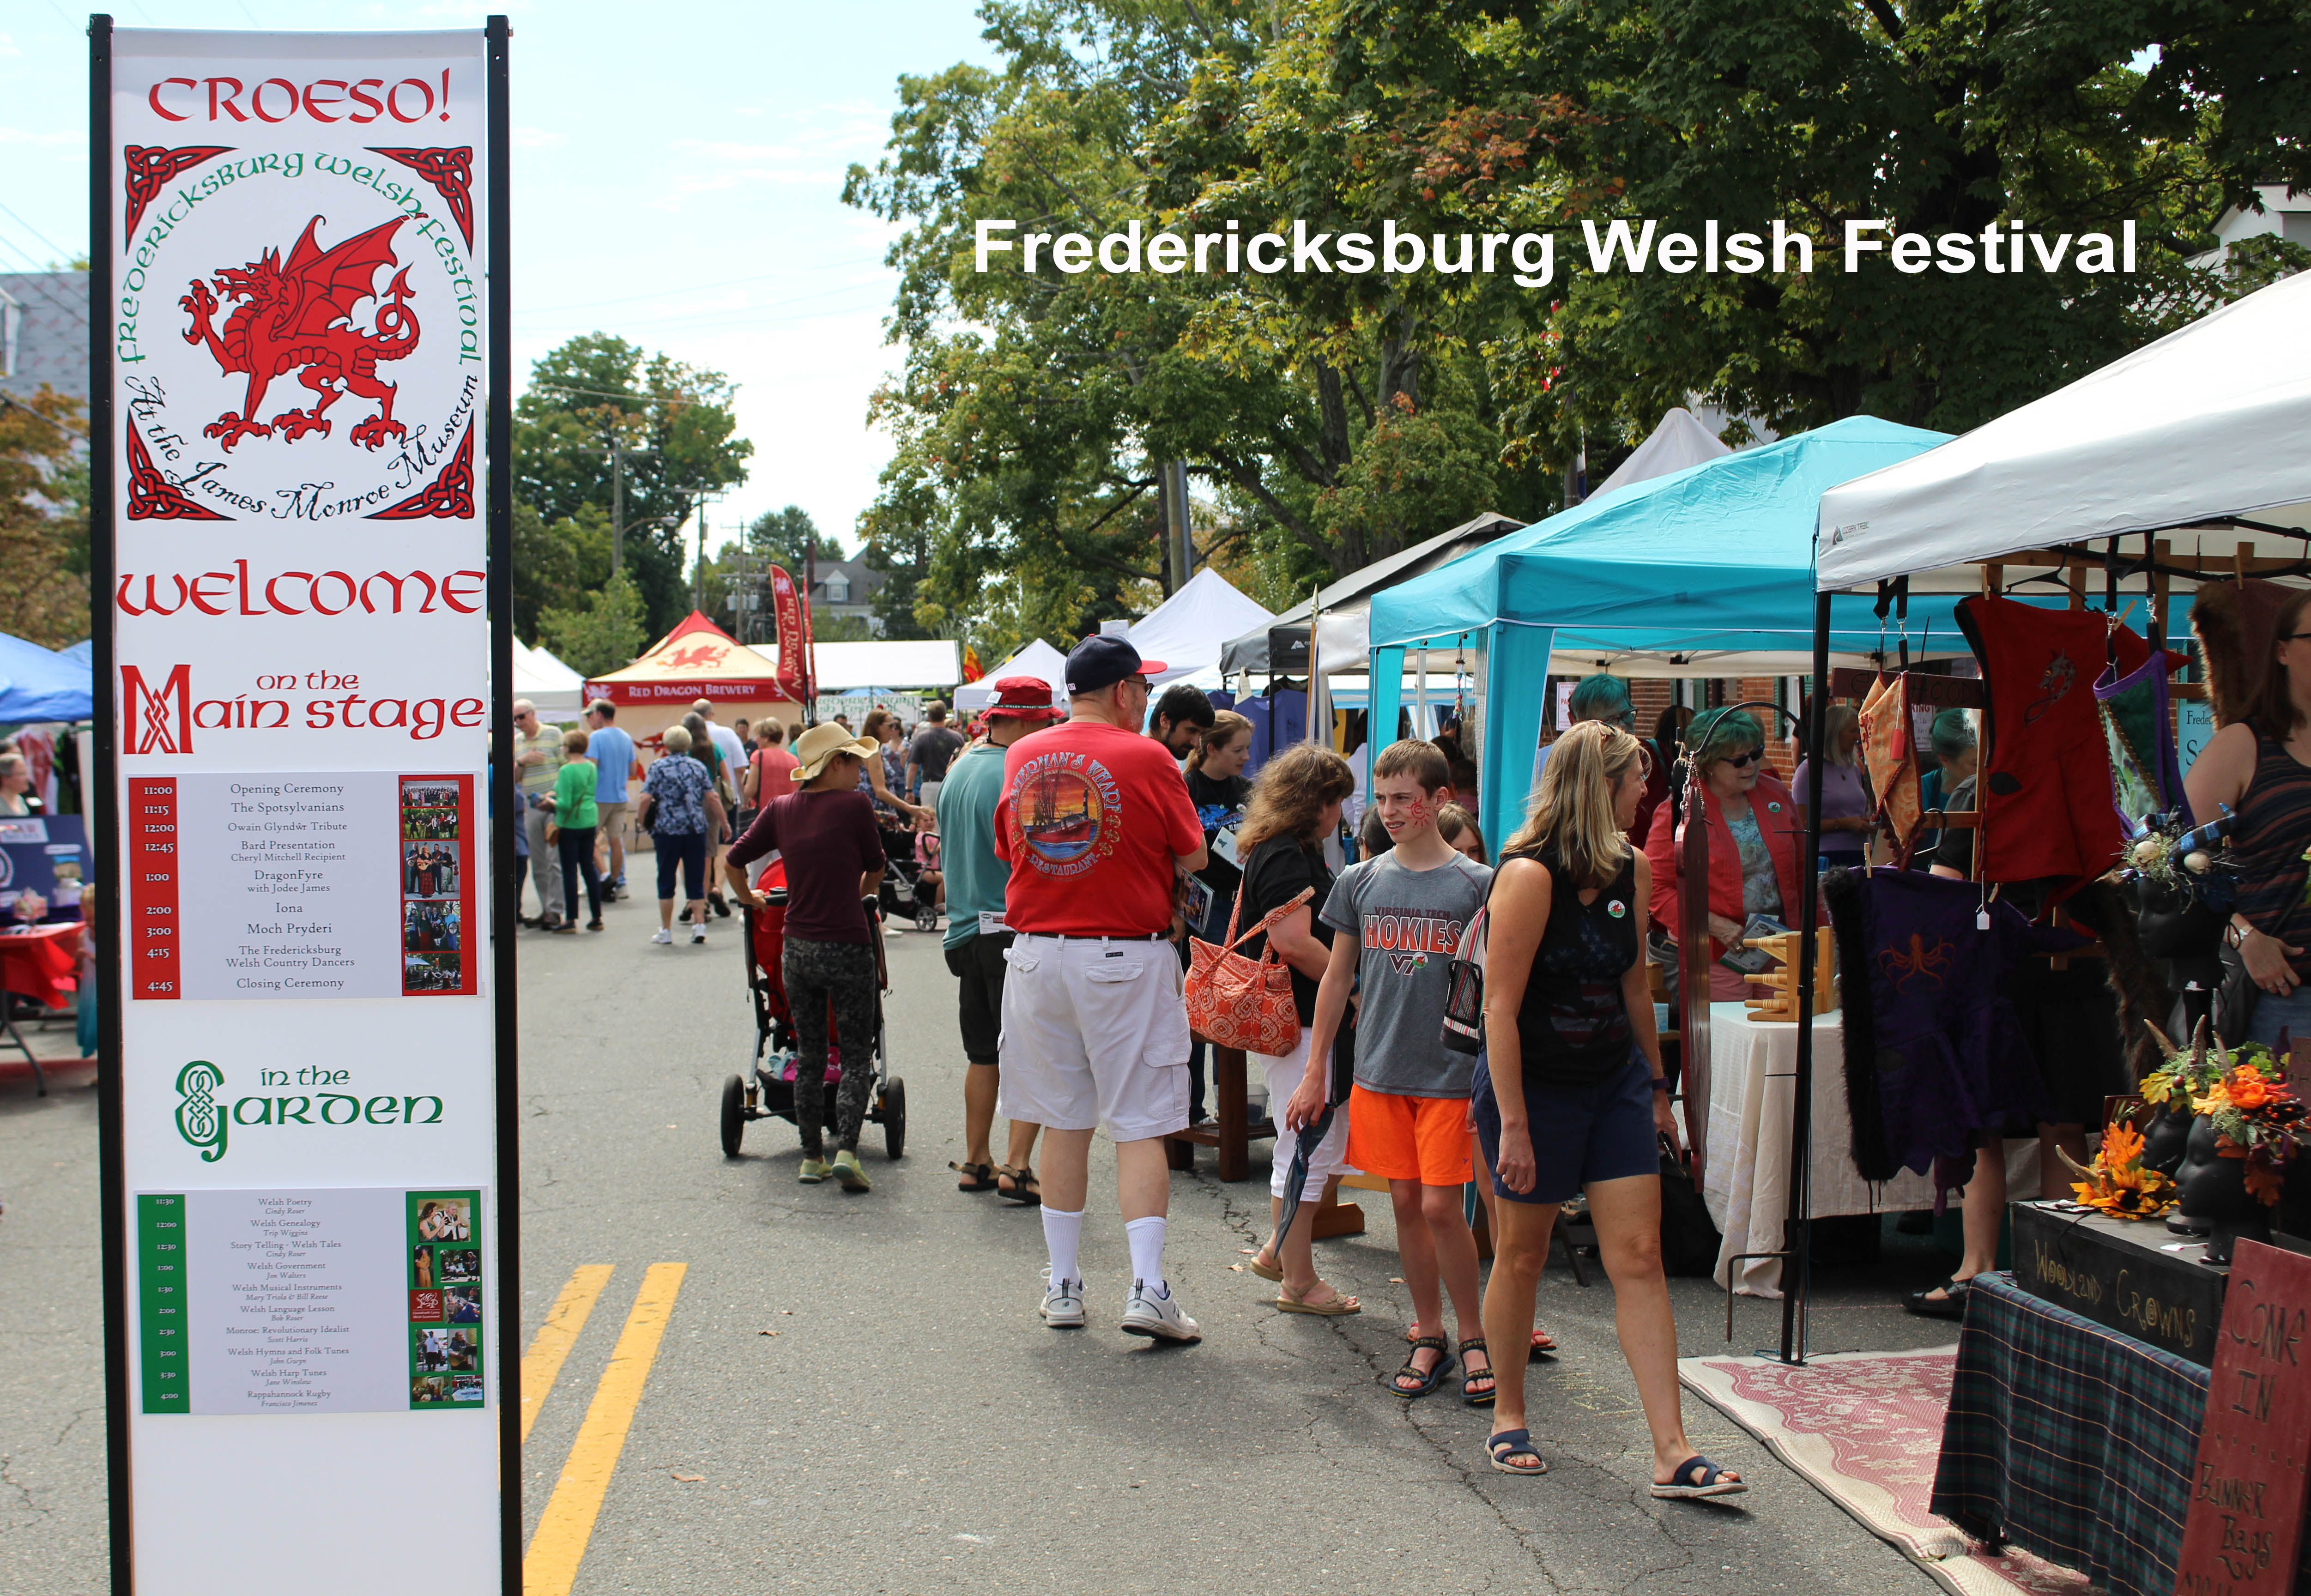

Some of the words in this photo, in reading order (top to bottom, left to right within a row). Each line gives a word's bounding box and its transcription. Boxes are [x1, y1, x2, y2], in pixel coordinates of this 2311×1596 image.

[149, 67, 450, 123] CROESO!
[125, 374, 168, 422] At
[386, 374, 478, 490] Museum
[147, 420, 190, 461] the
[164, 459, 267, 513] James
[270, 481, 390, 521] Monroe
[257, 676, 296, 689] on
[304, 670, 358, 689] the
[629, 686, 651, 697] RED
[654, 685, 702, 696] DRAGON
[705, 683, 756, 695] BREWERY
[144, 786, 173, 795] 11:00
[230, 784, 280, 796] Opening
[284, 783, 344, 796] Ceremony
[1086, 759, 1122, 813] WHARF
[144, 805, 169, 816] 11:15
[230, 802, 254, 812] The
[258, 801, 344, 816] Spotsylvanians
[145, 824, 175, 833] 12:00
[228, 822, 261, 831] Owain
[310, 821, 347, 830] Tribute
[145, 842, 174, 853] 12:45
[241, 840, 266, 850] Bard
[269, 840, 335, 850] Presentation
[230, 853, 261, 864] Cheryl
[264, 852, 302, 861] Mitchell
[304, 852, 345, 863] Recipient
[145, 873, 169, 882] 1:00
[254, 870, 323, 883] DragonFyre
[247, 883, 270, 892] with
[271, 883, 299, 894] Jodee
[300, 883, 330, 894] James
[146, 907, 172, 915] 2:00
[276, 902, 303, 913] Iona
[1375, 907, 1421, 917] VIRGINIA
[1425, 909, 1451, 919] TECH
[146, 927, 172, 938] 3:00
[248, 923, 282, 934] Moch
[287, 922, 332, 936] Pryderi
[1363, 914, 1463, 955] HOKIES
[146, 948, 169, 958] 4:15
[238, 945, 260, 955] The
[263, 944, 341, 956] Fredericksburg
[226, 957, 260, 967] Welsh
[264, 958, 308, 970] Country
[312, 957, 355, 967] Dancers
[147, 981, 173, 991] 4:45
[236, 978, 281, 991] Closing
[284, 977, 344, 990] Ceremony
[261, 1068, 290, 1086] in
[296, 1065, 350, 1085] the
[257, 1197, 284, 1206] Welsh
[286, 1198, 313, 1208] Poetry
[278, 1219, 321, 1228] Genealogy
[230, 1241, 253, 1250] Story
[254, 1241, 284, 1250] Telling
[268, 1305, 306, 1314] Language
[2117, 1269, 2196, 1348] CROWNS
[2231, 1280, 2305, 1366] COME
[262, 1326, 318, 1335] Revolutionary
[256, 1348, 286, 1357] Hymns
[279, 1369, 300, 1378] Harp
[247, 1390, 304, 1400] Rappahannock
[306, 1389, 331, 1399] Rugby
[2232, 1368, 2276, 1424] IN
